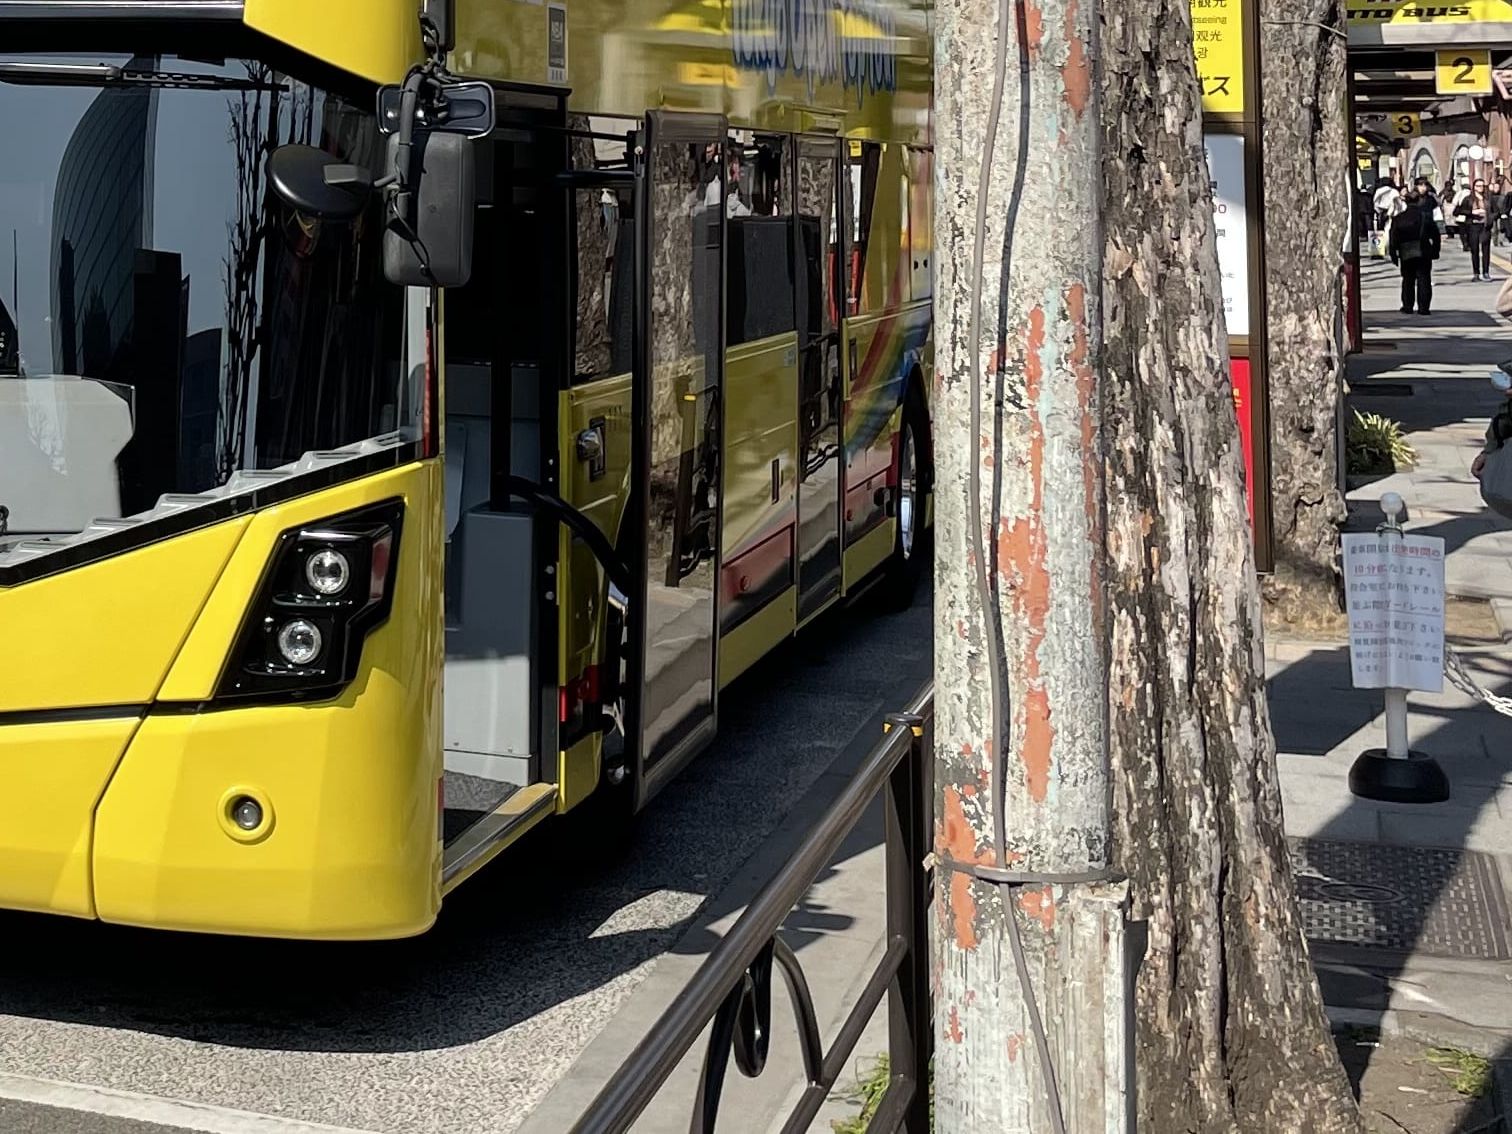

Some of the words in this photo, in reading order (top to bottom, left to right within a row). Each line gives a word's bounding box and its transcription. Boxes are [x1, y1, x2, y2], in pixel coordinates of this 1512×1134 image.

[1402, 6, 1472, 18] BUS
[1191, 30, 1223, 42] 观光
[1451, 57, 1476, 85] 2
[1397, 115, 1414, 135] 3
